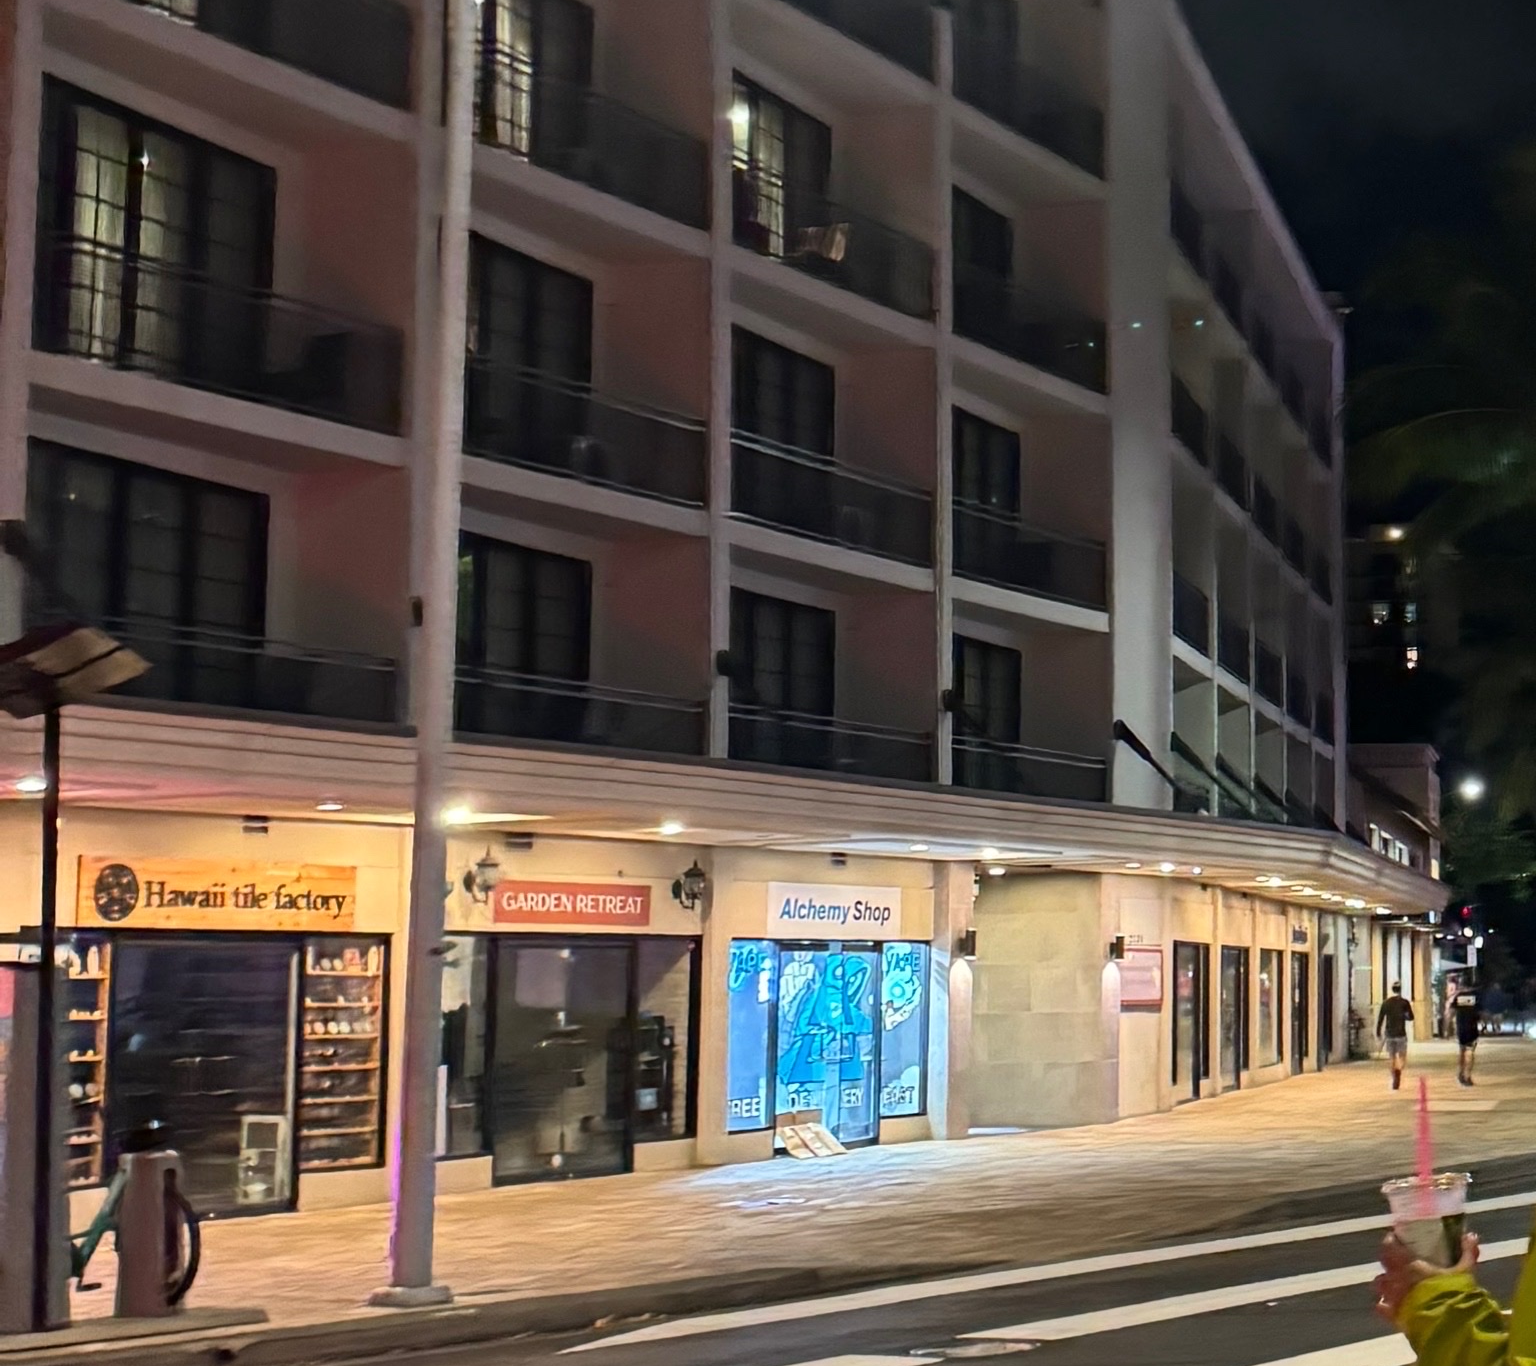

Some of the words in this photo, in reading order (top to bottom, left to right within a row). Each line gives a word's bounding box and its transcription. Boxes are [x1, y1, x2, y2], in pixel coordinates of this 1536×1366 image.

[143, 880, 226, 909] Hawaii
[232, 882, 268, 910] tile
[274, 883, 347, 920] factory
[501, 891, 573, 912] GARDEN
[576, 894, 644, 914] RETREAT
[779, 897, 851, 925] Alchemy
[852, 900, 891, 926] Shop
[728, 1096, 760, 1117] REE
